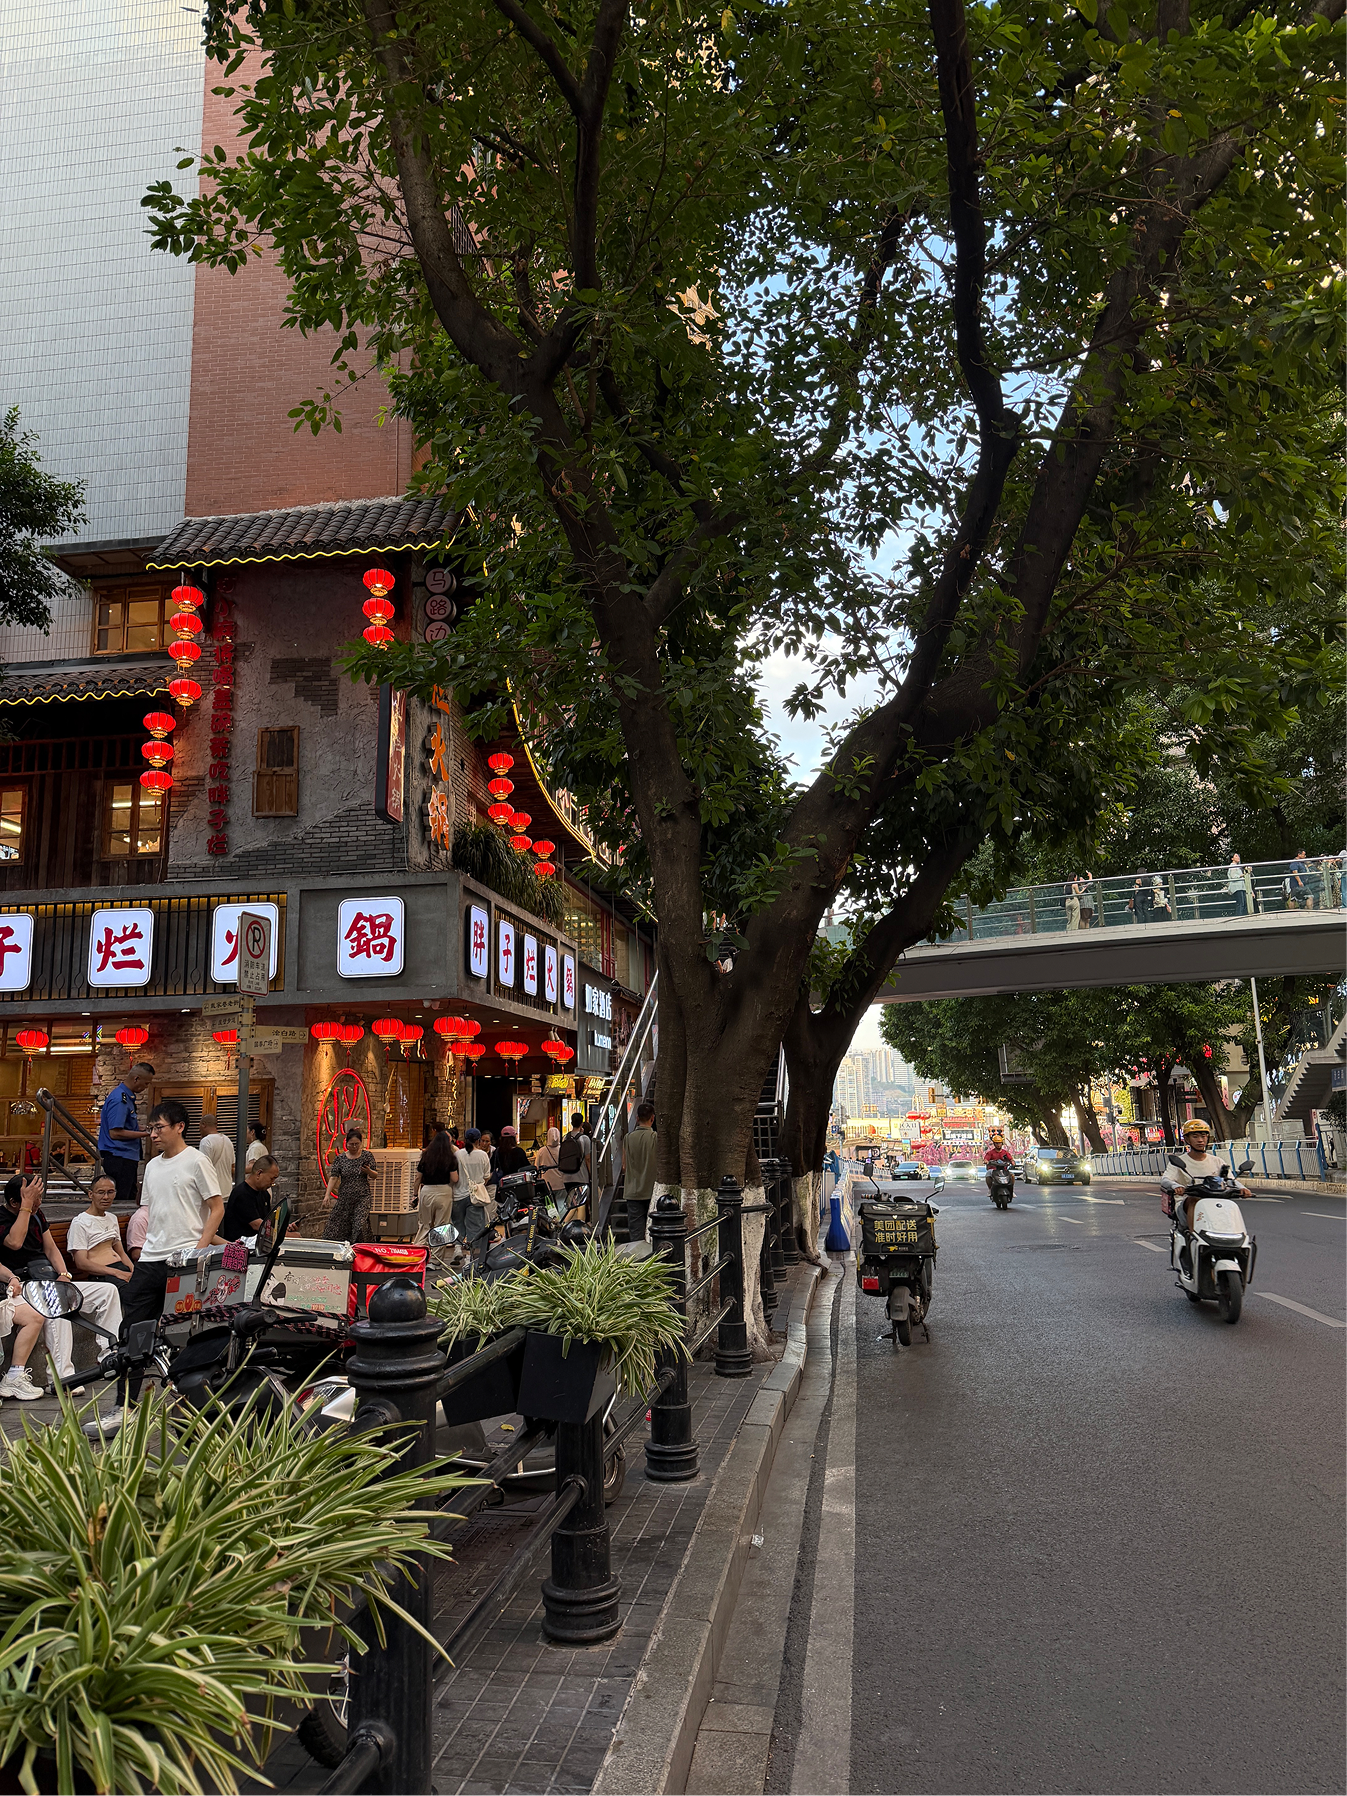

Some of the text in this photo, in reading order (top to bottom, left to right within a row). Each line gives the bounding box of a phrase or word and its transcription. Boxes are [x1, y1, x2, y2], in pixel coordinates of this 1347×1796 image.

[873, 1219, 917, 1231] 美团配送
[874, 1231, 918, 1243] 准时好用
